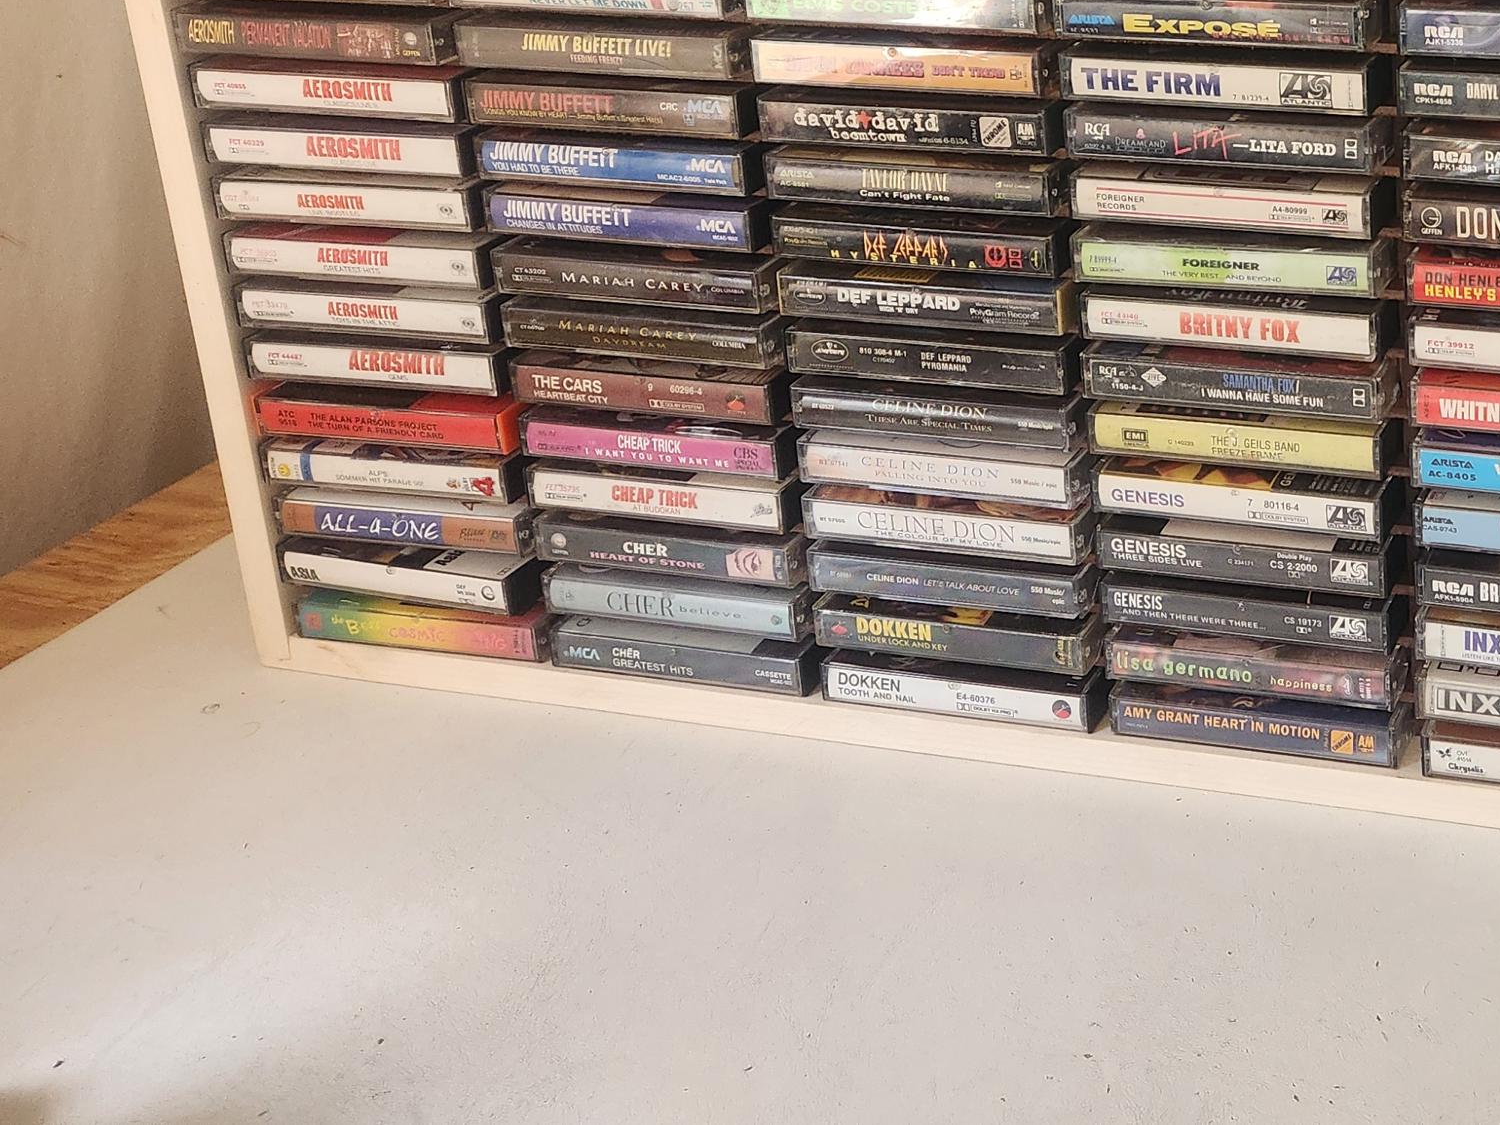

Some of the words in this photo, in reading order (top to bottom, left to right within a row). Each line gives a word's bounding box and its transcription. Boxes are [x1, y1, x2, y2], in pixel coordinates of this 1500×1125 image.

[302, 79, 393, 102] AEROSMITH
[831, 128, 907, 142] boomtown
[1249, 139, 1288, 154] LITA
[1291, 141, 1336, 156] FORD
[1096, 194, 1145, 203] FOREIGNER
[1097, 202, 1136, 211] RECORDS
[503, 199, 557, 221] JIMMY
[561, 205, 631, 226] BUFFETT
[1179, 312, 1253, 339] BRITNY
[1260, 318, 1300, 343] FOX
[533, 374, 563, 391] THE
[565, 377, 603, 394] CARS
[1110, 489, 1184, 509] GENESIS
[289, 567, 319, 581] ASIA
[612, 647, 641, 660] CHER
[612, 658, 666, 673] GREATEST
[669, 663, 694, 676] HITS
[1116, 651, 1154, 672] lisa
[1162, 659, 1252, 683] germano
[837, 671, 901, 692] DOKKEN
[1123, 706, 1152, 721] AMY
[1156, 711, 1199, 727] GRANT
[1203, 715, 1246, 731] HEART
[1250, 719, 1264, 733] IN
[1268, 721, 1320, 741] MOTION
